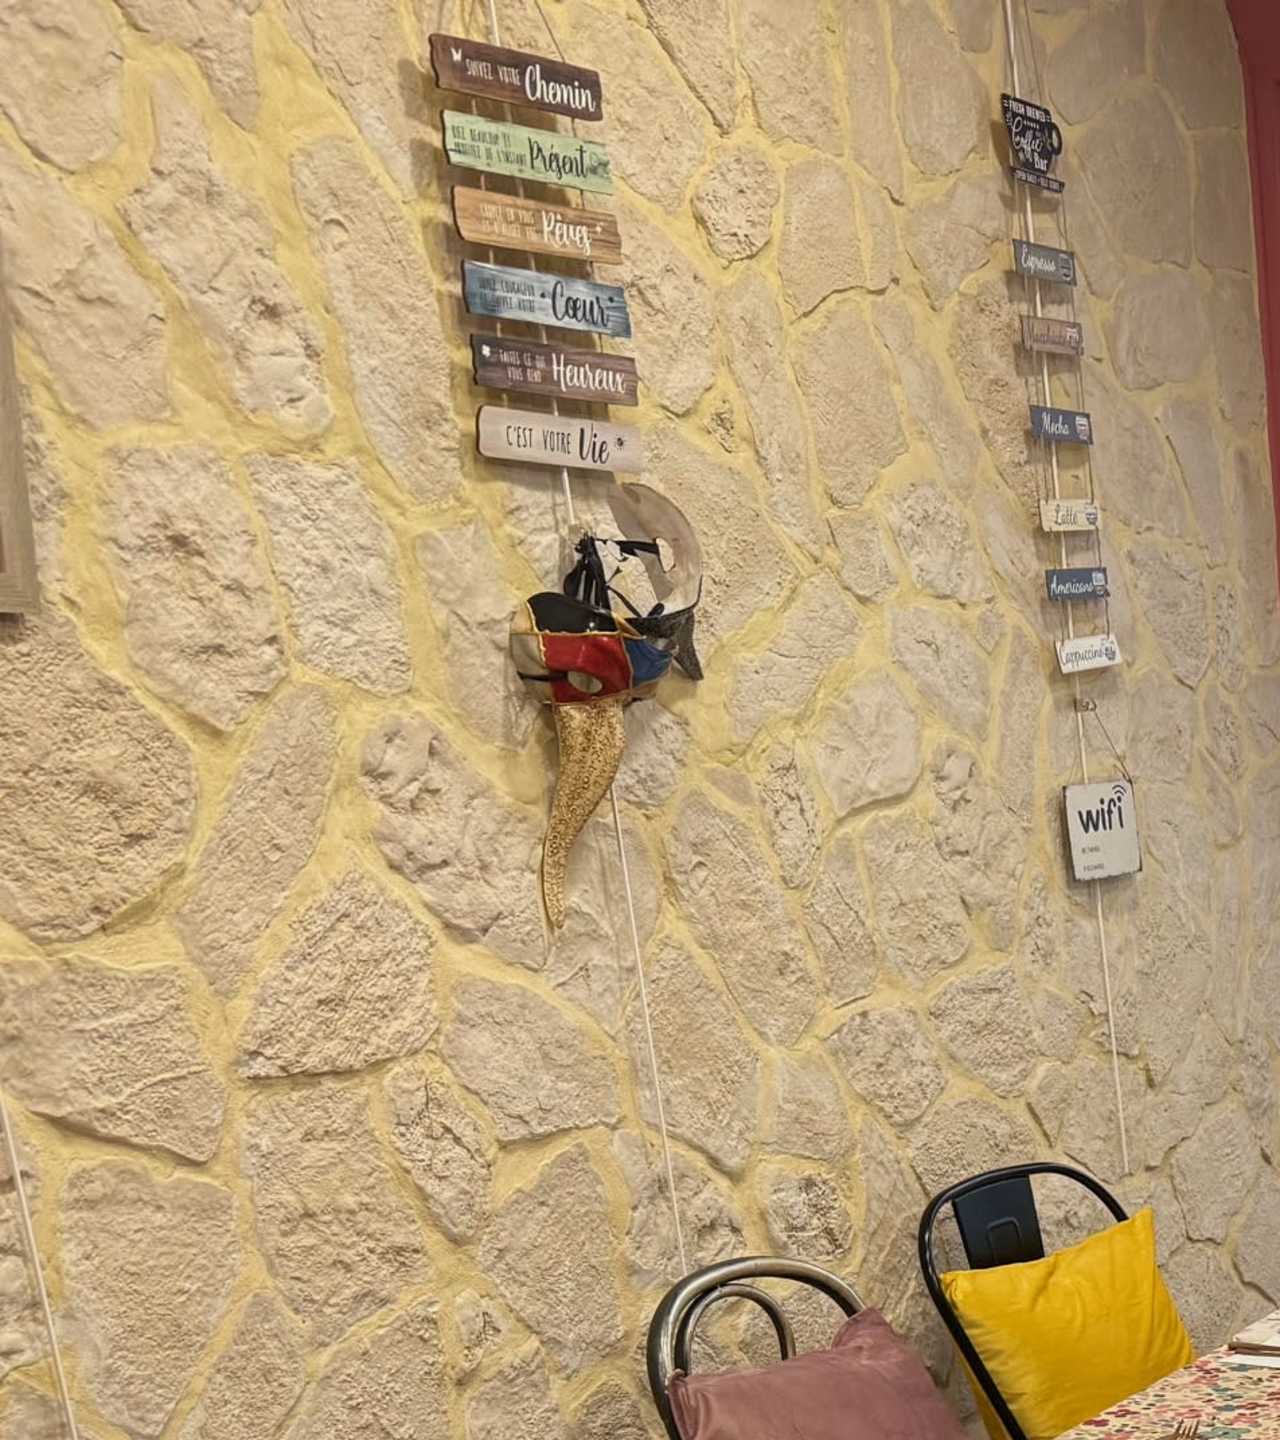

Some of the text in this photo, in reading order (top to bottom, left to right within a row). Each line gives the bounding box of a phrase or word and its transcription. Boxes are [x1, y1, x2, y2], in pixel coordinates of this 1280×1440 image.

[525, 64, 596, 112] Chemin
[527, 136, 588, 180] Présent
[541, 210, 592, 257] Rêves
[552, 353, 625, 394] Heureux
[1041, 411, 1069, 435] Mocha
[506, 422, 609, 465] C'EST VOTRE Vie
[1054, 503, 1078, 526] Latte
[1050, 574, 1094, 597] Americano
[1060, 644, 1104, 668] Cappuccino
[1077, 795, 1125, 834] wifi
